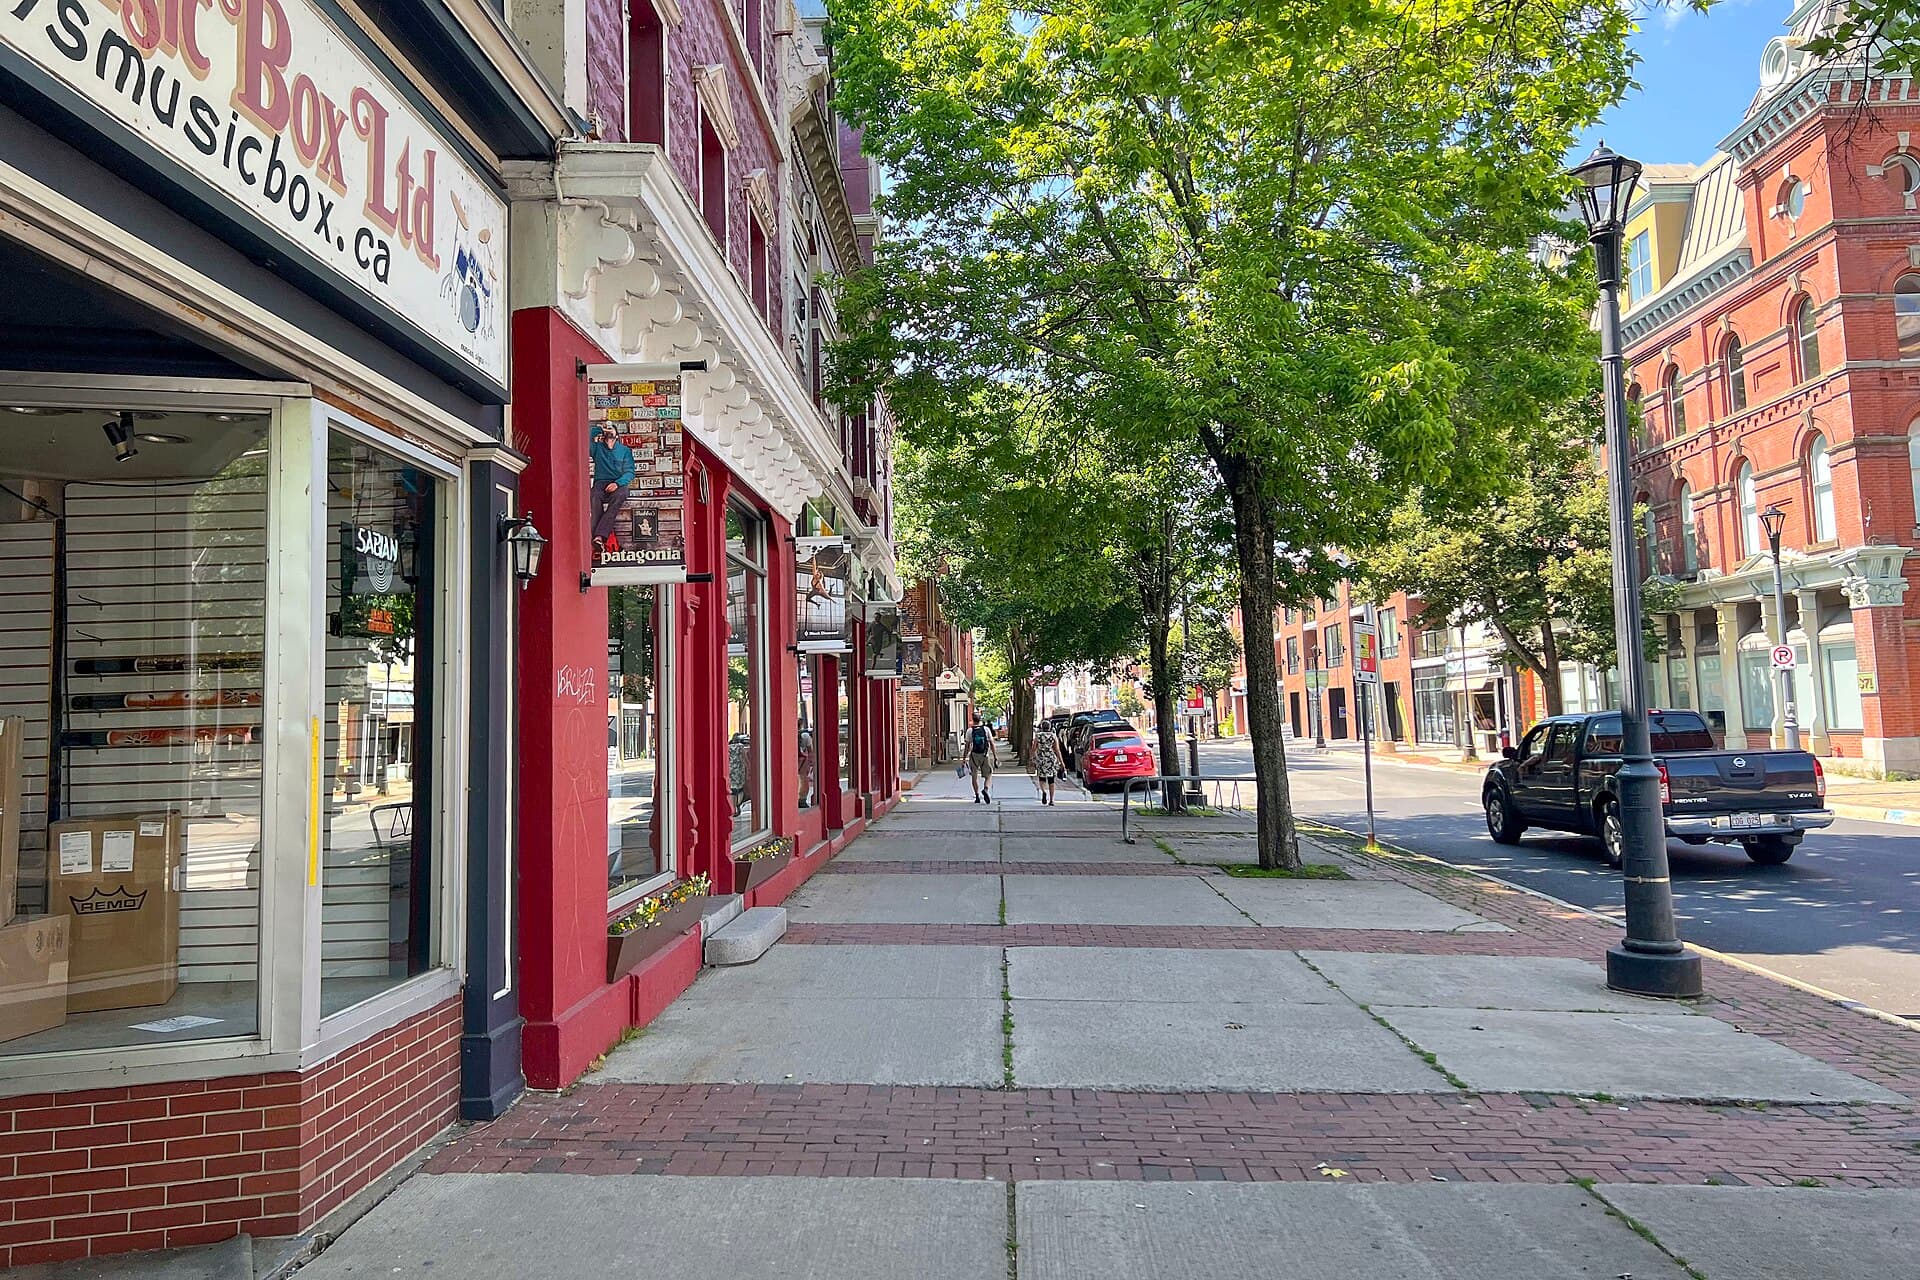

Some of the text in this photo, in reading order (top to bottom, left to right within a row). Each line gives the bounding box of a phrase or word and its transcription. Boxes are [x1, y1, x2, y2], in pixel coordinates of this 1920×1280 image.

[351, 86, 441, 273] Ltd.
[356, 527, 398, 563] SABIAN
[601, 547, 681, 565] patagonia
[80, 898, 138, 912] REMO
